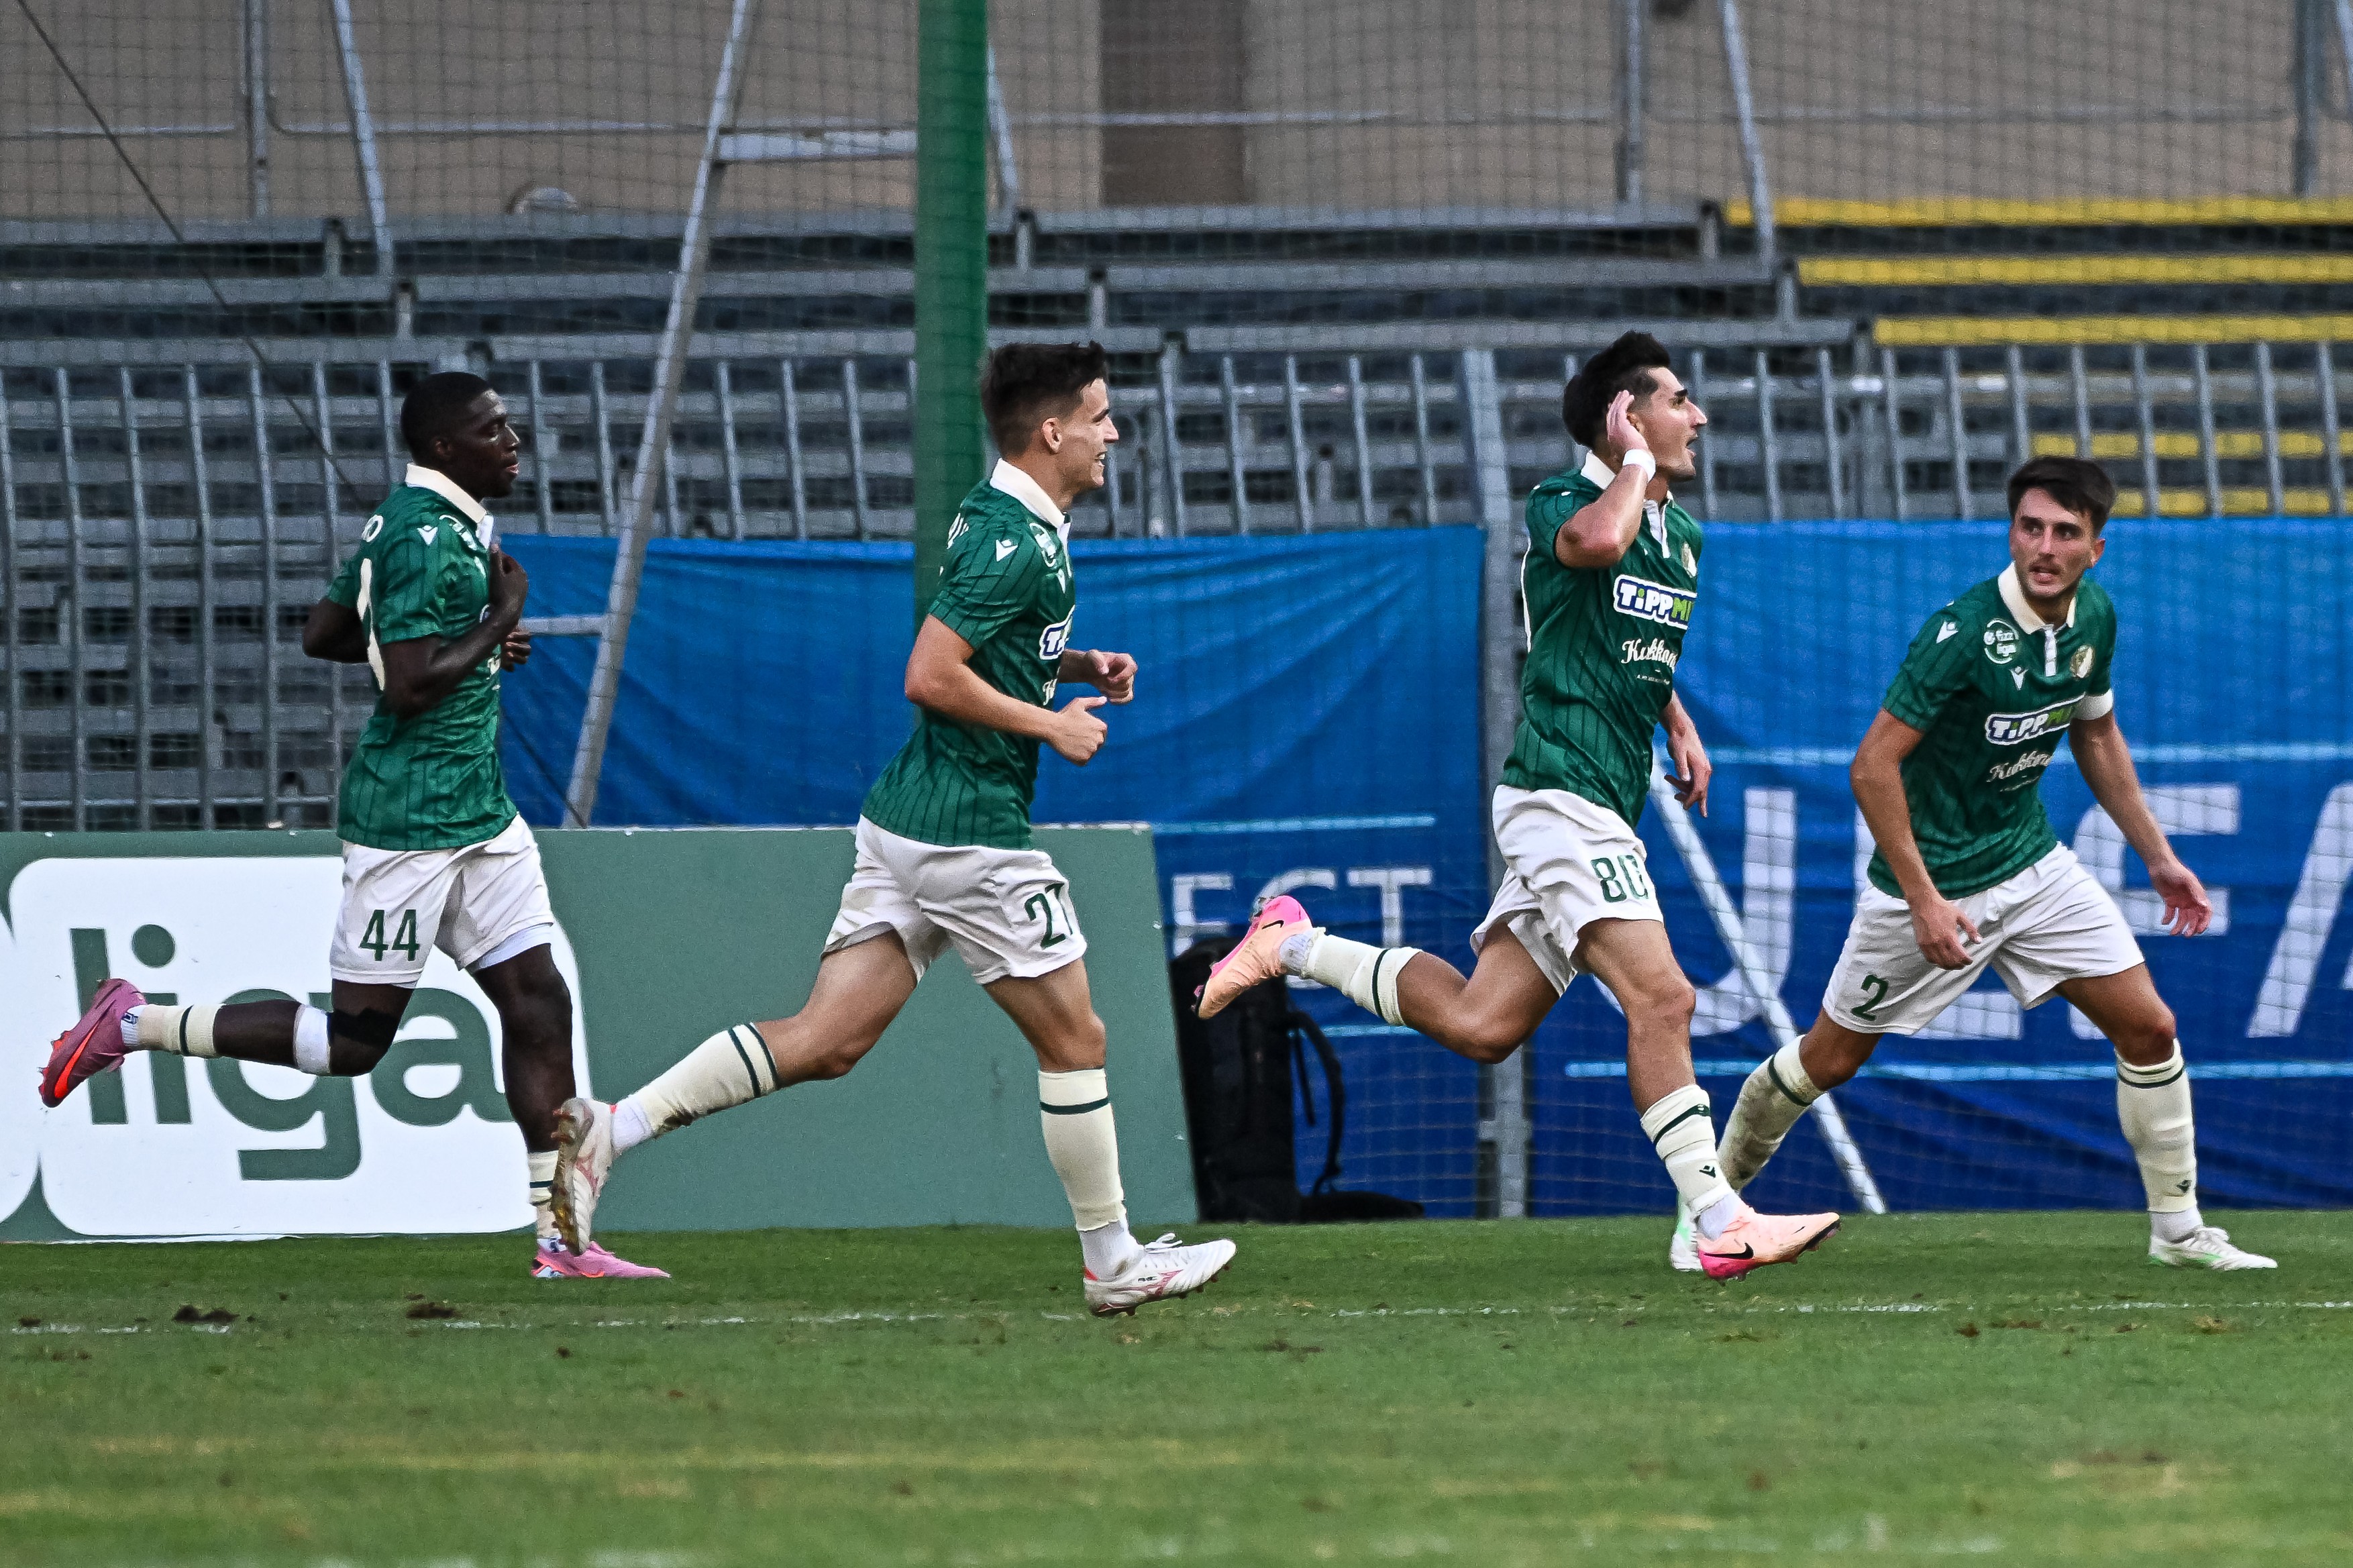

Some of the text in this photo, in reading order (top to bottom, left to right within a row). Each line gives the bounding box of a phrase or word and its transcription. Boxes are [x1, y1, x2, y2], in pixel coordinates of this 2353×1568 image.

[1619, 581, 1695, 623] TiPPMI
[358, 908, 421, 962] 44
[1850, 974, 1889, 1022] 2
[69, 923, 517, 1182] liga
